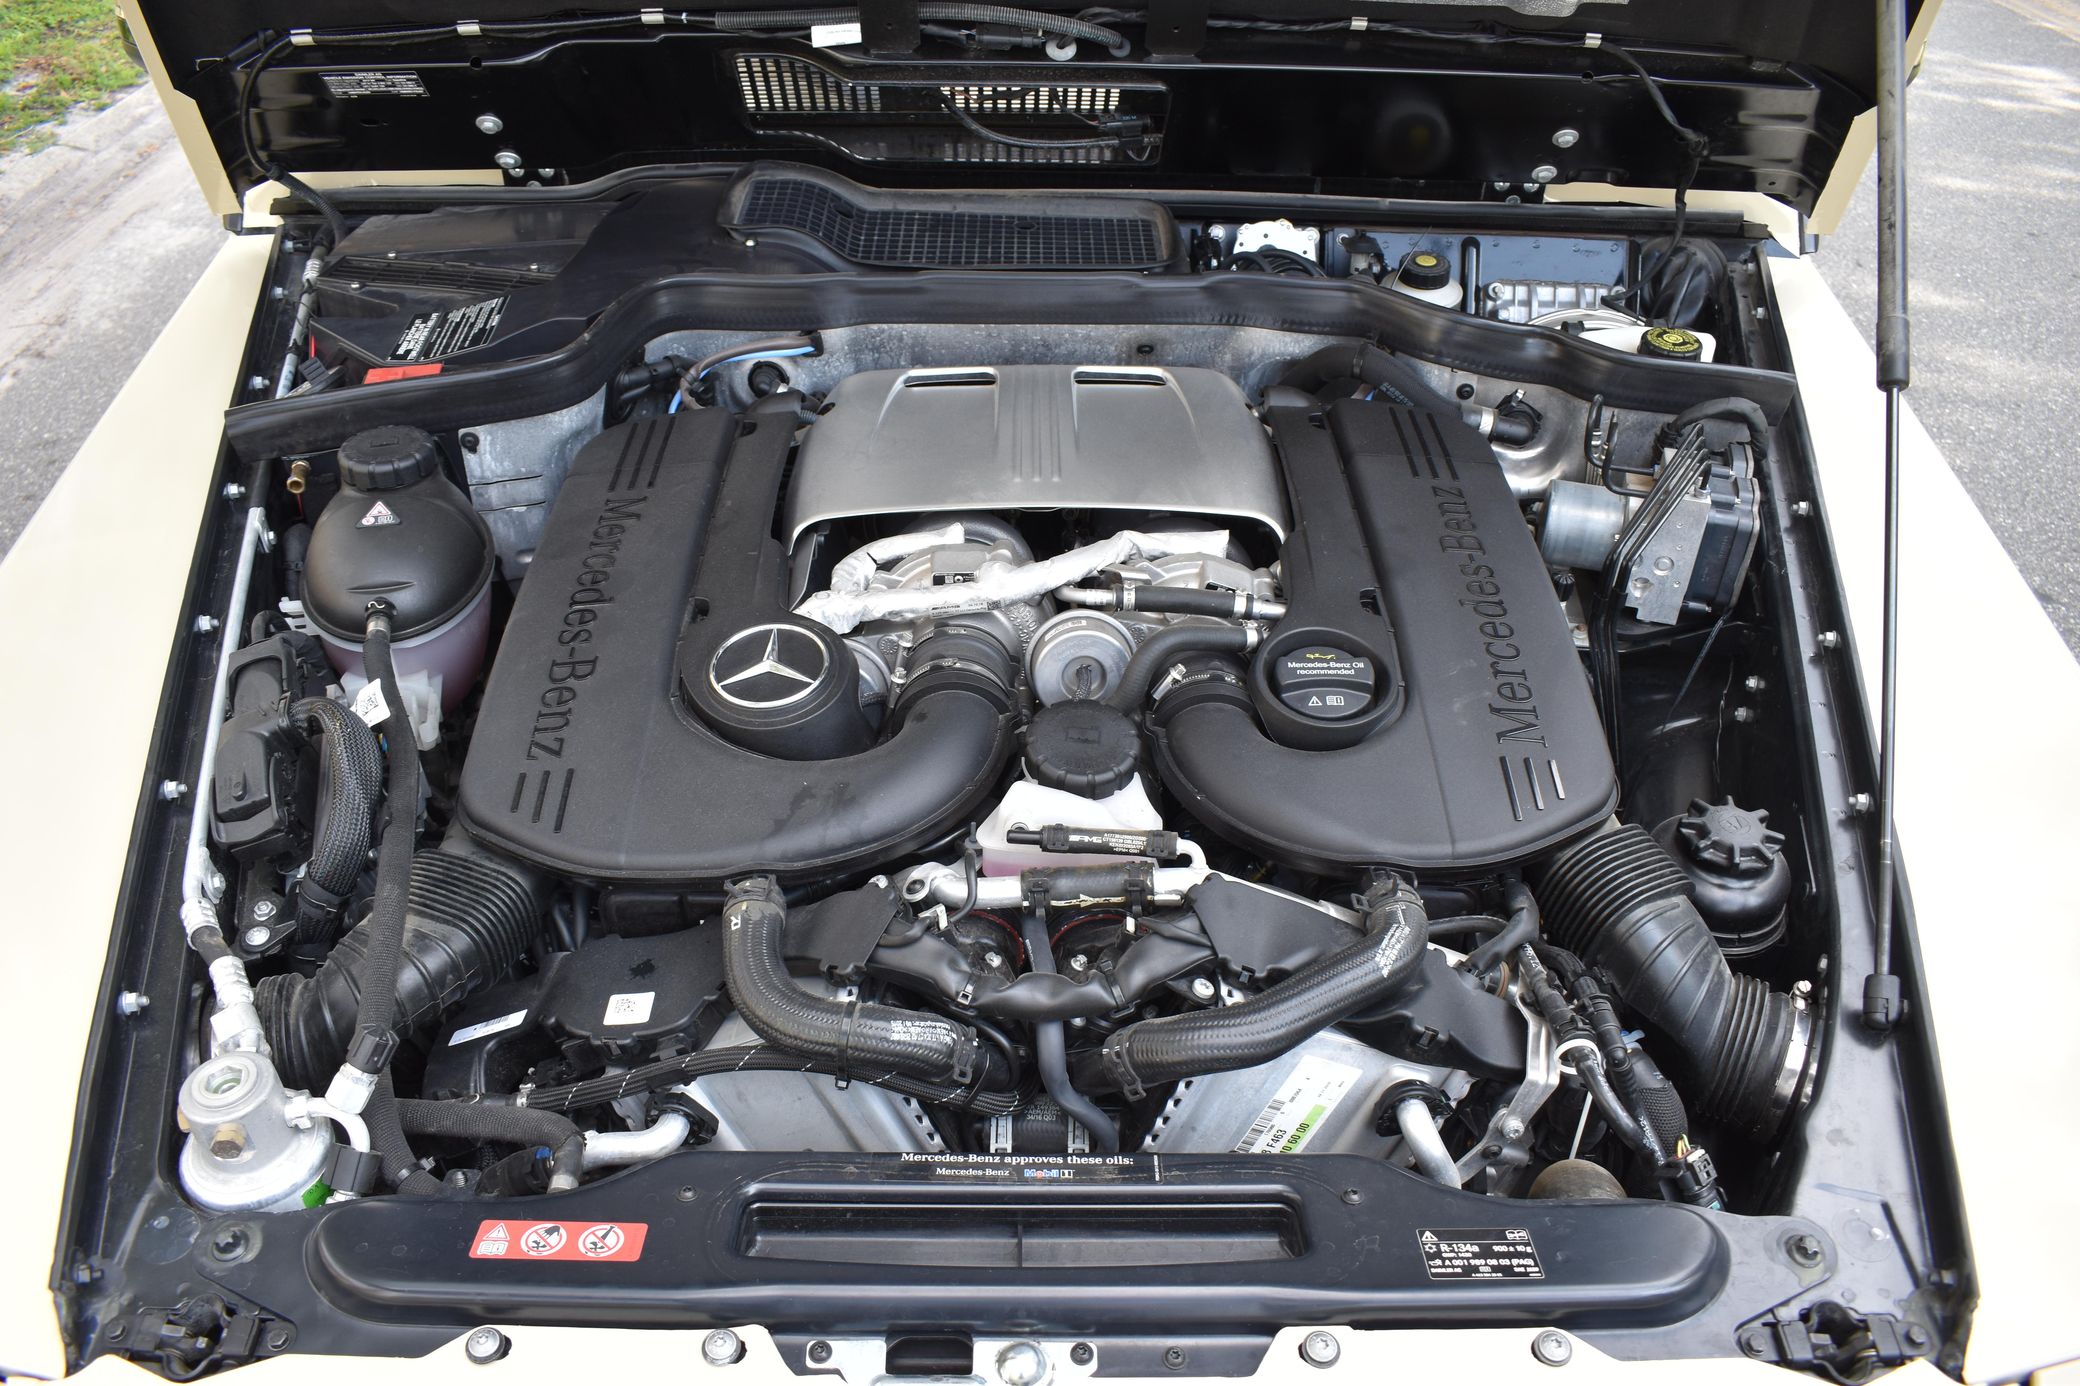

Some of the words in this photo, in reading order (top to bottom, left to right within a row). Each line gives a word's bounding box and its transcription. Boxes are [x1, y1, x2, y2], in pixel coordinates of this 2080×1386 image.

[1433, 486, 1548, 748] Mercedes-Benz
[526, 496, 647, 760] Mercedes-Benz
[1076, 835, 1102, 843] AMG
[1266, 1129, 1287, 1148] F463
[1287, 1134, 1301, 1144] 60
[1296, 1122, 1310, 1133] 00
[901, 1152, 1000, 1162] Mercedes-Benz
[1004, 1155, 1063, 1165] approves
[1067, 1155, 1103, 1165] these
[1106, 1155, 1134, 1165] oils:
[936, 1167, 1010, 1176] Mercedes-Benz
[1024, 1169, 1059, 1178] Mobil
[1440, 1243, 1480, 1252] R-134a
[1511, 1258, 1534, 1266] (PAG)
